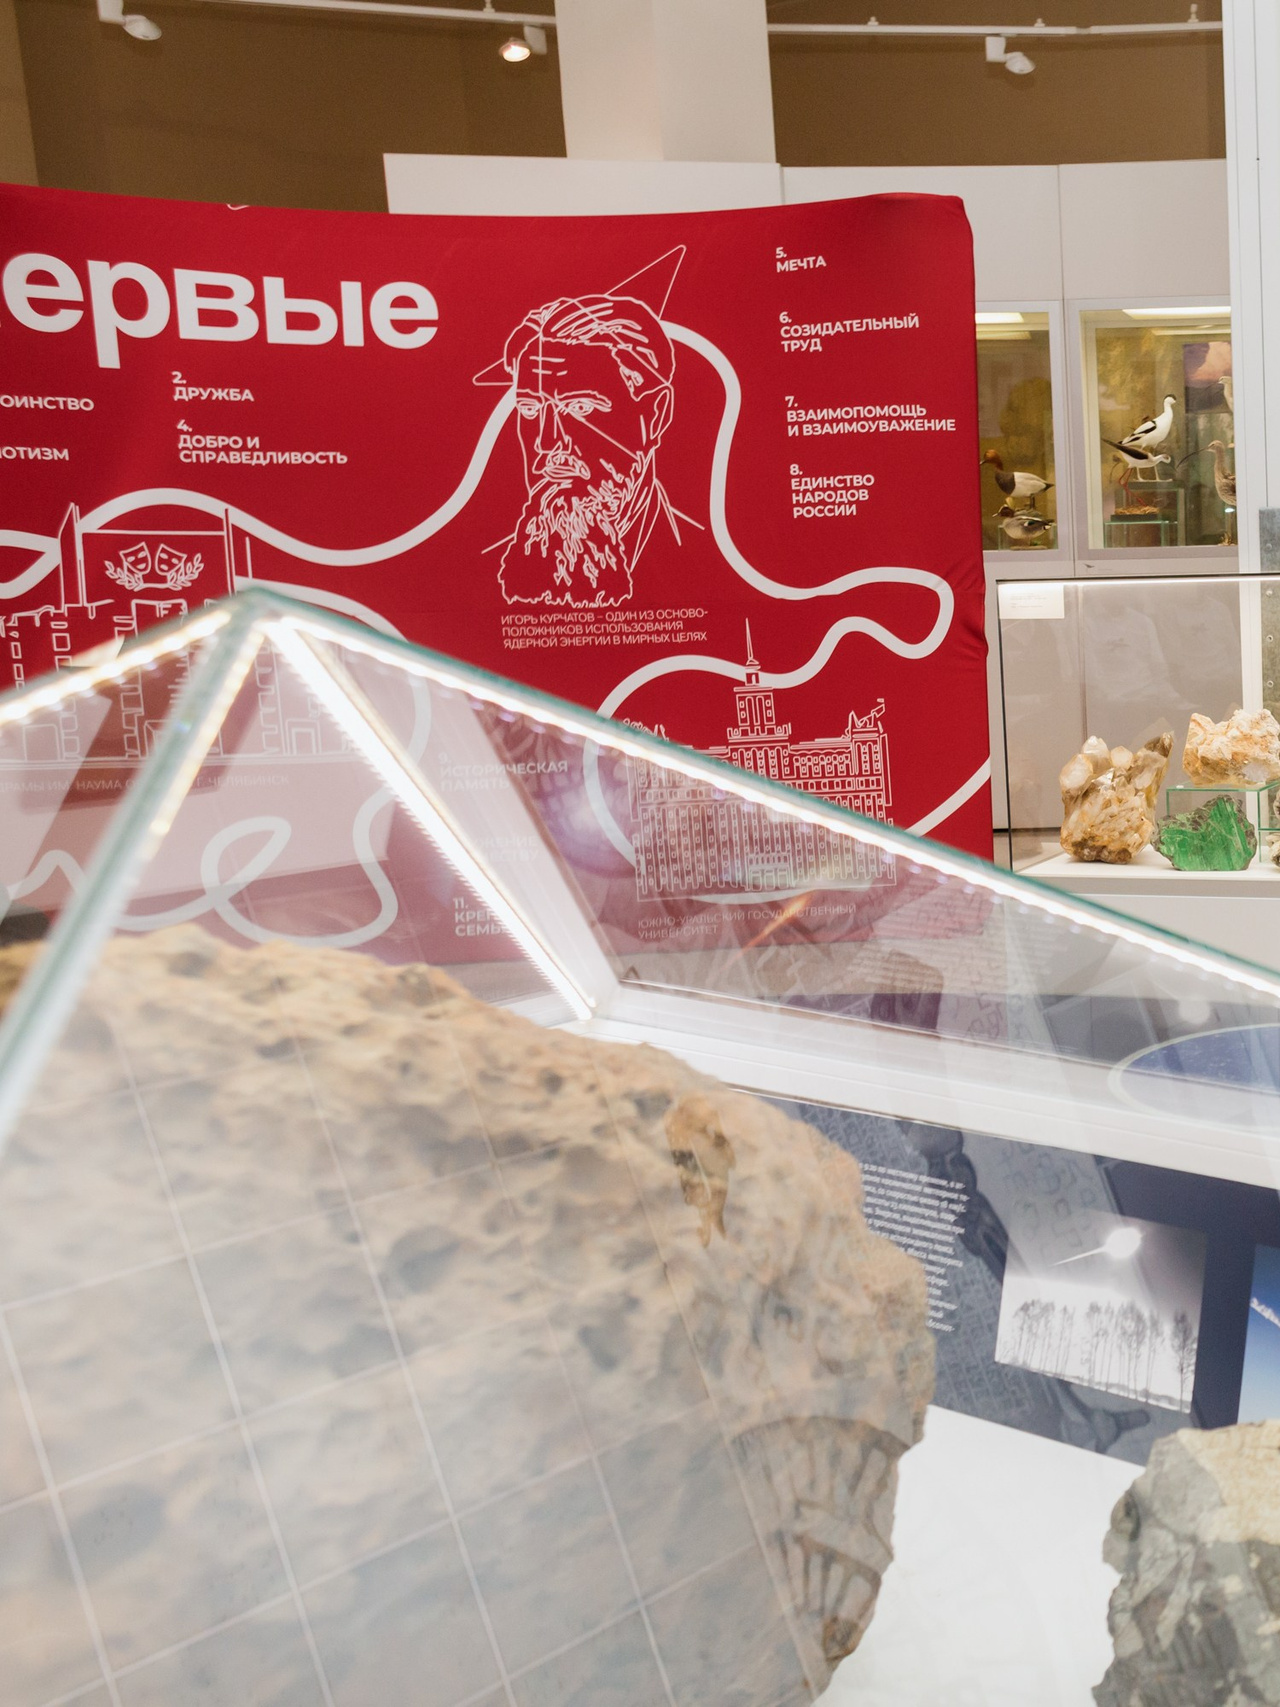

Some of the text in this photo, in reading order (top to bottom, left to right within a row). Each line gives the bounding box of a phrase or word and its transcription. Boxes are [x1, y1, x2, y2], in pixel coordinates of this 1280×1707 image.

[775, 247, 787, 259] 5.
[776, 255, 827, 273] МЕЧТА
[0, 252, 440, 369] ервые
[779, 311, 792, 324] 6.
[780, 312, 920, 338] СОЗИДАТЕЛЬНЫЙ
[781, 337, 823, 353] ТРУД
[171, 371, 187, 384] 2.
[173, 386, 254, 402] ДРУЖБА
[785, 395, 798, 408] 7.
[787, 404, 927, 422] ВЗАИМОПОМОЩЬ
[177, 419, 193, 432] 4.
[788, 419, 956, 437] И ВЗАИМОУВАЖЕНИЕ
[178, 434, 260, 450] ДОБРО И
[0, 446, 70, 461] ОТИЗМ
[179, 450, 348, 466] СПРАВЕДЛИВОСТЬ
[790, 463, 803, 475] 8.
[791, 474, 875, 491] ЕДИНСТВО
[792, 489, 869, 504] НАРОДОВ
[793, 504, 857, 519] РОССИИ
[501, 614, 538, 625] ИГОРЬ
[540, 612, 595, 623] КУРЧАТОВ
[605, 611, 637, 622] ОДИН
[639, 610, 655, 620] ИЗ
[656, 608, 708, 619] ОСНОВО-
[502, 621, 683, 637] ПОЛОЖНИКОВ ИСПОЛЬЗОВАНИЯ
[504, 631, 707, 650] ЯДЕРНОЙ ЭНЕРГИИ В МИРНЫХ ЦЕЛЯХ
[440, 760, 568, 777] ИСТОРИЧЕСКАЯ
[76, 780, 122, 790] НАУМА
[440, 777, 510, 792] ПАМЯТЬ
[453, 898, 468, 909] 11.
[638, 904, 857, 929] ЮЖНО-УРАЛЬСКИЙ ГОСУДАРСТВЕННЫЙ
[638, 925, 718, 940] УНИВЕРСИТЕТ
